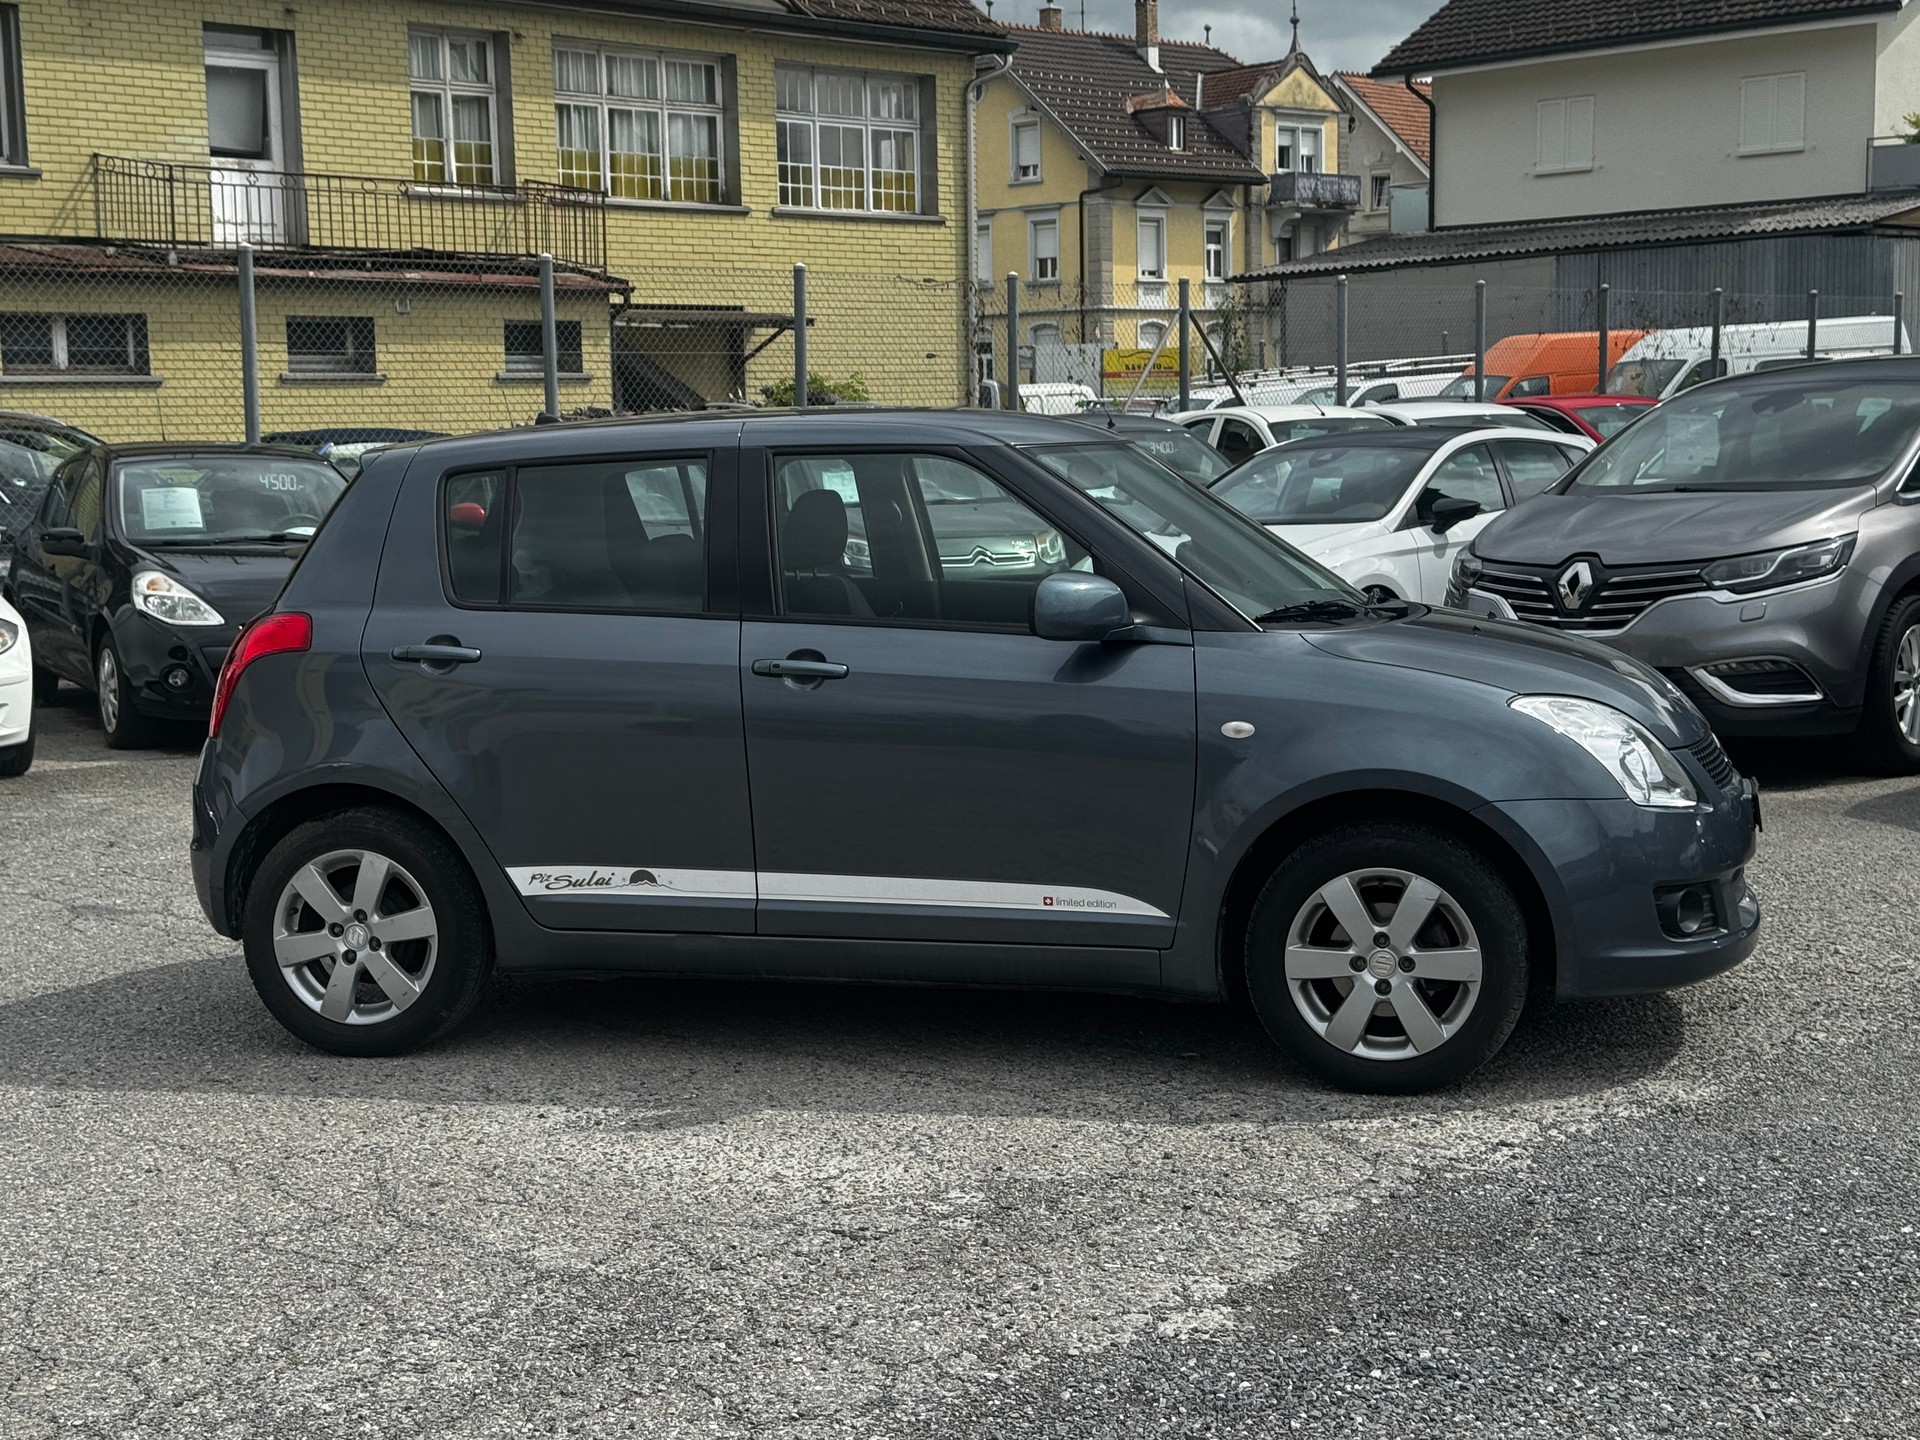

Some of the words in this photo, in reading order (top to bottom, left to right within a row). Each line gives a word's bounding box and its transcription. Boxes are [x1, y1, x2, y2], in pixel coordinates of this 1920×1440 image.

[528, 872, 552, 886] Piz
[545, 870, 616, 890] Sulai
[1055, 896, 1085, 907] limited
[1086, 898, 1117, 909] edition
